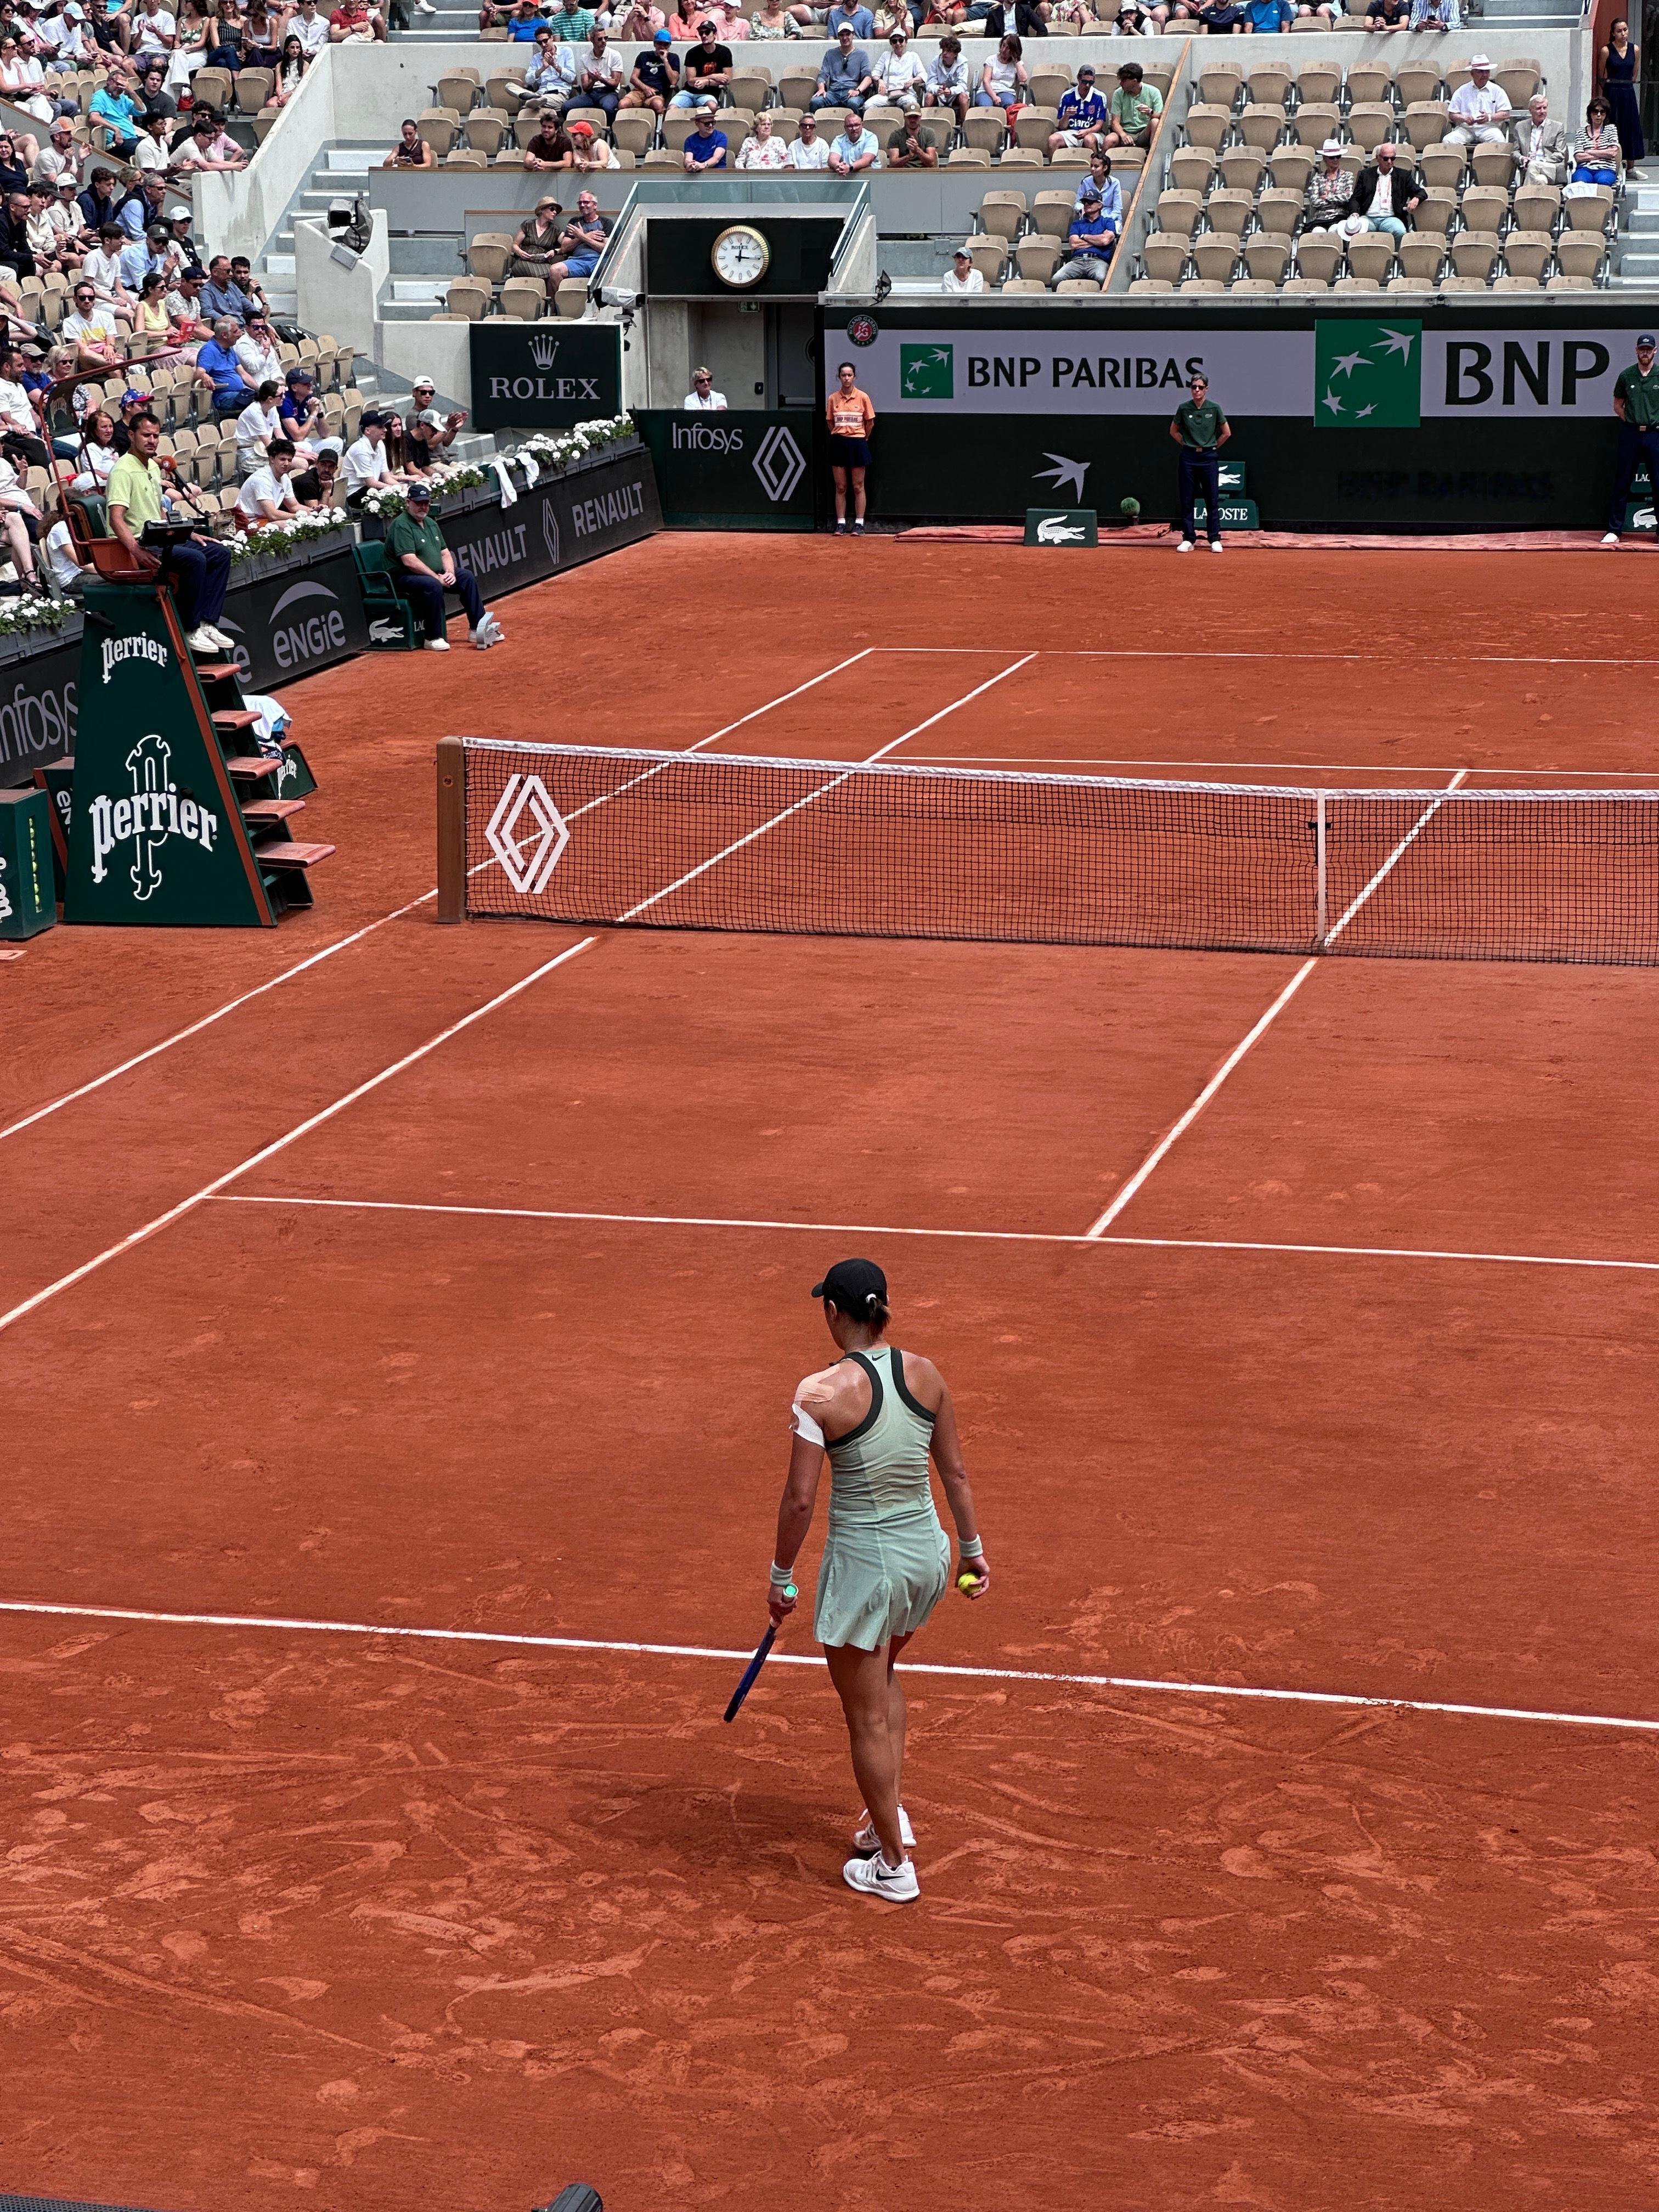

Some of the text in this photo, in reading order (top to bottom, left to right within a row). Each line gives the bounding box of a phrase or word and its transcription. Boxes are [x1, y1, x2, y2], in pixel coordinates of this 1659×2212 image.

[1068, 117, 1091, 128] Claro
[489, 377, 601, 400] ROLEX
[968, 357, 1209, 388] BNP PARIBAS
[1444, 341, 1610, 405] BNP
[673, 422, 743, 455] Infosys
[572, 482, 644, 538] RENAULT
[1193, 507, 1248, 521] LAOSTE
[450, 523, 527, 577] ENAULT
[0, 681, 78, 764] nfosys
